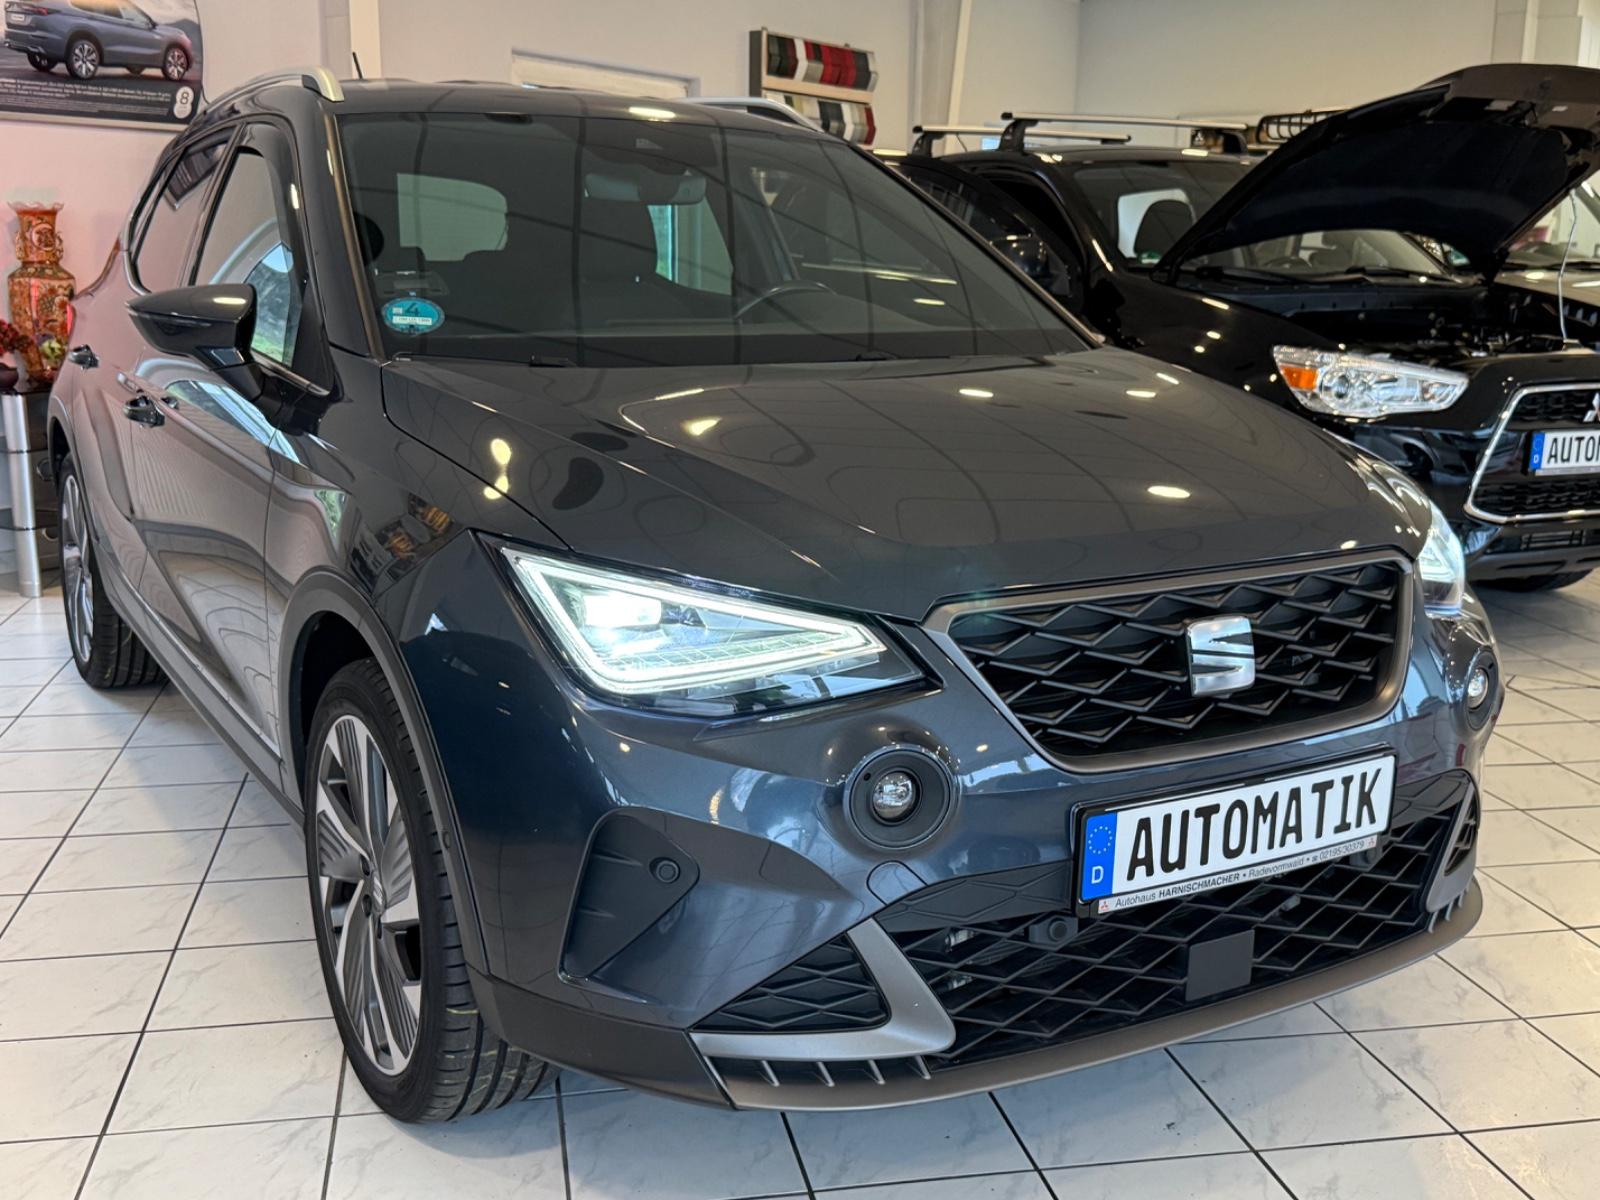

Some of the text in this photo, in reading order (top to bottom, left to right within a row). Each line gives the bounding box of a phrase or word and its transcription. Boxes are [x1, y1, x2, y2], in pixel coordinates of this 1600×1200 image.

[180, 91, 190, 105] 8
[1533, 454, 1539, 464] D
[1091, 767, 1382, 884] D AUTOMATIK
[1114, 892, 1156, 908] Autohaus
[1157, 871, 1240, 899] HARNISCHMACHER
[1248, 856, 1305, 878] Radevormwald
